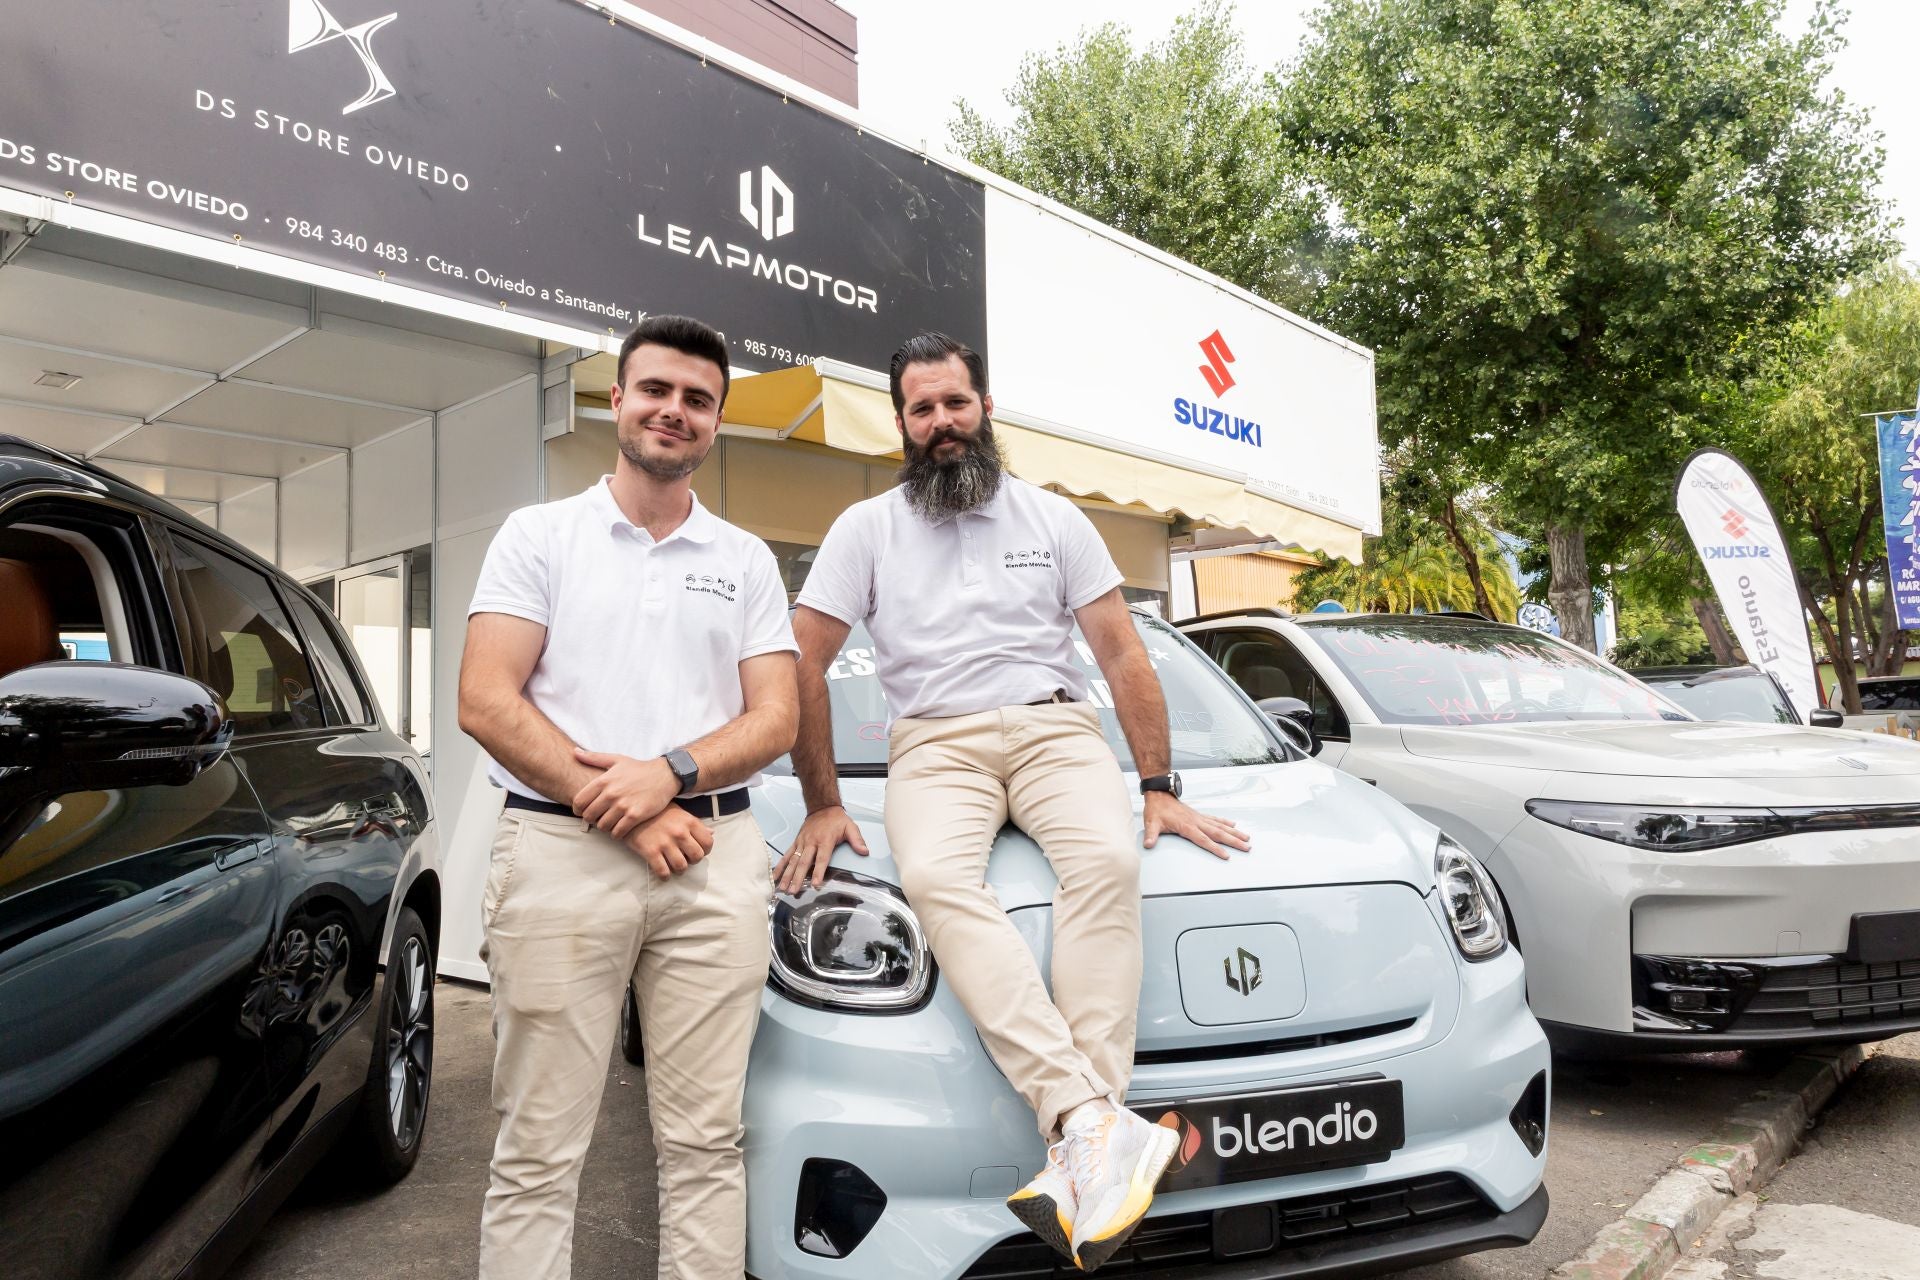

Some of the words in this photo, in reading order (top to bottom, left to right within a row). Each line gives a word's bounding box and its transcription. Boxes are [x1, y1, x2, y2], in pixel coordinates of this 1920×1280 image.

[196, 90, 236, 119] DS
[254, 109, 350, 156] STORE
[366, 145, 470, 192] OVIEDO
[0, 138, 35, 165] DS
[46, 152, 138, 193] STORE
[146, 180, 249, 222] OVIEDO
[286, 216, 324, 243] 984
[330, 228, 367, 254] 340
[373, 240, 408, 264] 483
[426, 255, 469, 280] Ctra.
[475, 268, 536, 297] Oviedo
[541, 289, 549, 300] a
[555, 288, 633, 324] Santander,
[744, 338, 767, 357] 985
[770, 345, 792, 363] 793
[638, 213, 878, 314] LEAPMOTOR
[1173, 397, 1262, 448] SUZUKI
[1212, 1101, 1378, 1158] blendio
